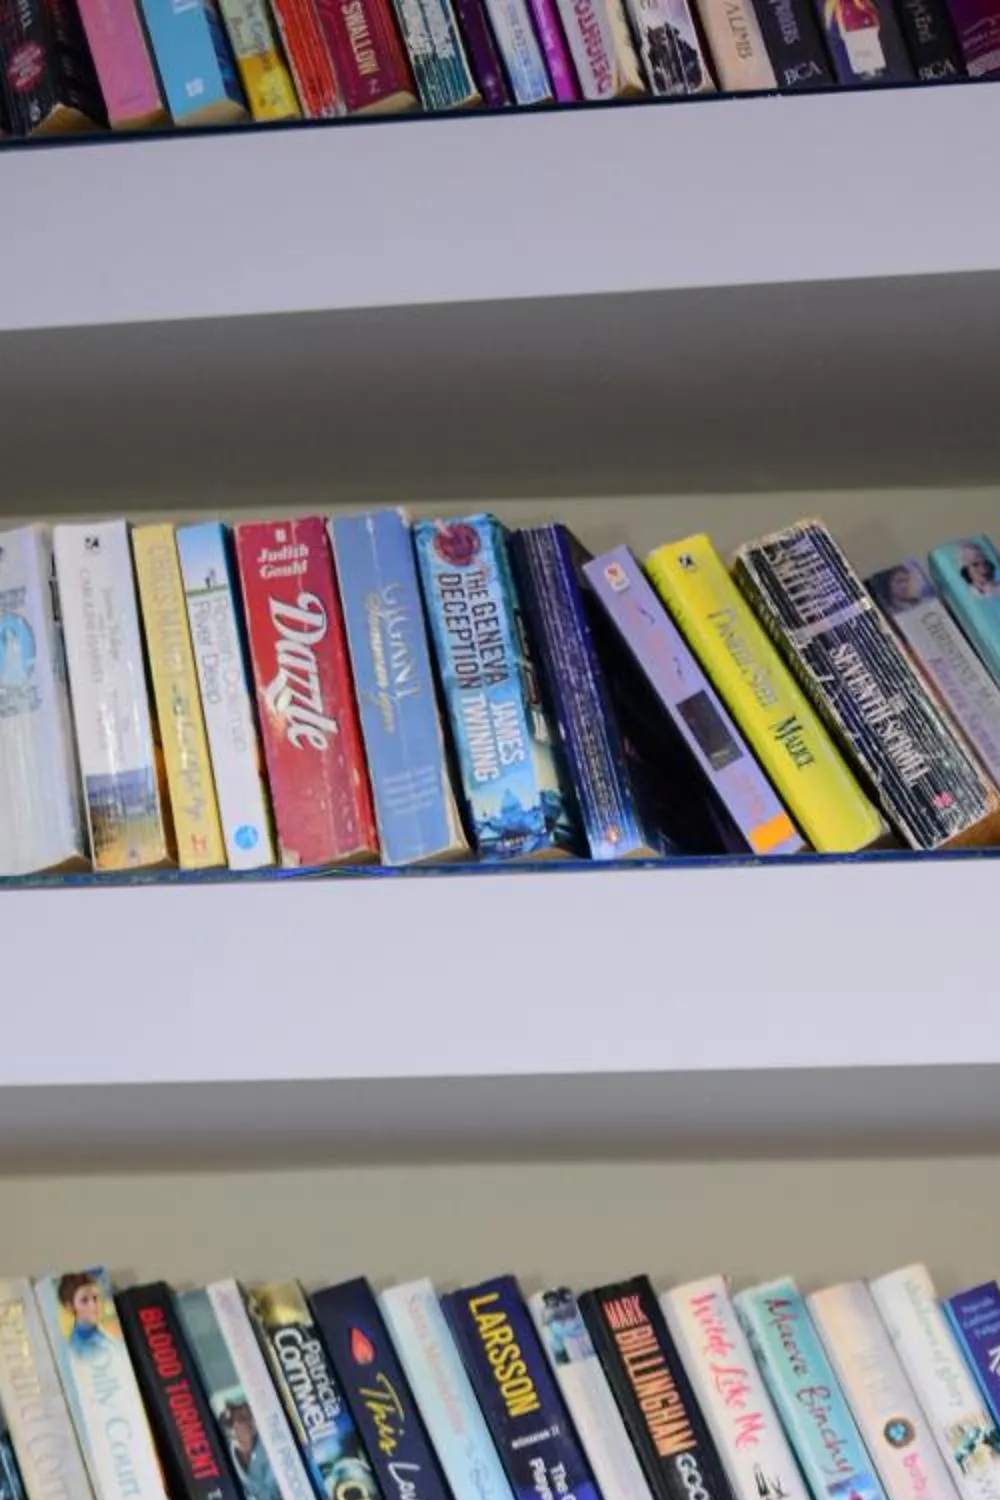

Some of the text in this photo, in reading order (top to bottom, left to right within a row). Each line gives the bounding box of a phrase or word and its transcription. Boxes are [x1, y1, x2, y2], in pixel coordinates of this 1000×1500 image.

[258, 545, 309, 563] Judith
[260, 561, 307, 579] Gould
[263, 593, 338, 750] Dazzle
[437, 573, 481, 690] DECEPTION
[462, 570, 508, 684] THE GENEVA
[462, 696, 498, 782] TWINNING
[491, 701, 525, 765] JAMES
[829, 642, 931, 788] SEVENTH SCROLL
[468, 1293, 541, 1418] LARSSON
[602, 1295, 649, 1329] MARK
[138, 1306, 220, 1480] BLOOD TORMENT
[273, 1327, 336, 1445] Cornwell
[301, 1338, 341, 1414] Patricia
[359, 1371, 406, 1457] This
[614, 1323, 697, 1457] BILLINGHAM
[691, 1293, 768, 1449] Wilde Like Me
[766, 1296, 855, 1478] Maeve Binchy
[106, 1416, 141, 1497] Court
[549, 1461, 566, 1496] The
